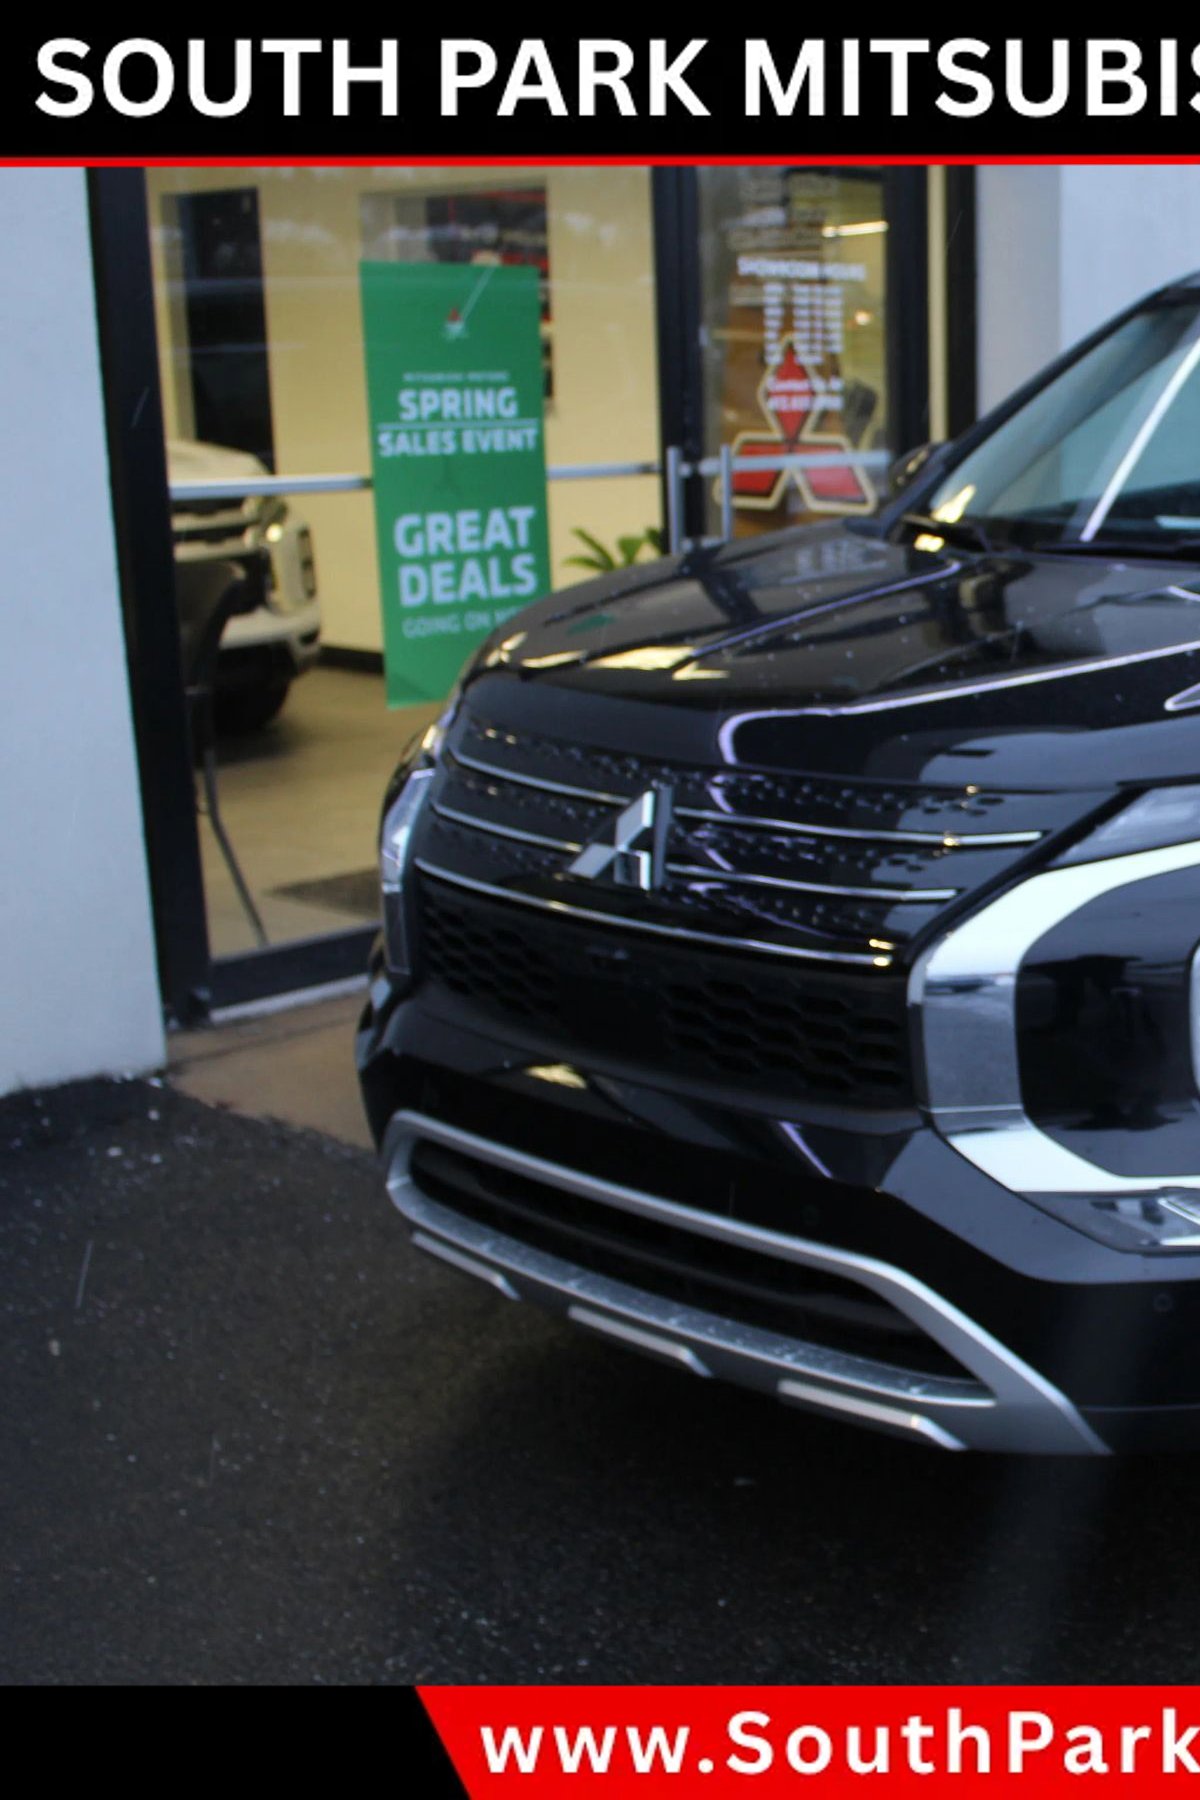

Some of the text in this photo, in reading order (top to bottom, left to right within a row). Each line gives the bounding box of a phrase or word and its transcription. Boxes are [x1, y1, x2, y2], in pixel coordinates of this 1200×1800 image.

[398, 386, 518, 421] SPRING
[378, 427, 538, 457] SALES EVENT
[394, 505, 536, 558] GREAT
[398, 553, 538, 609] DEALS
[402, 613, 461, 639] GOING
